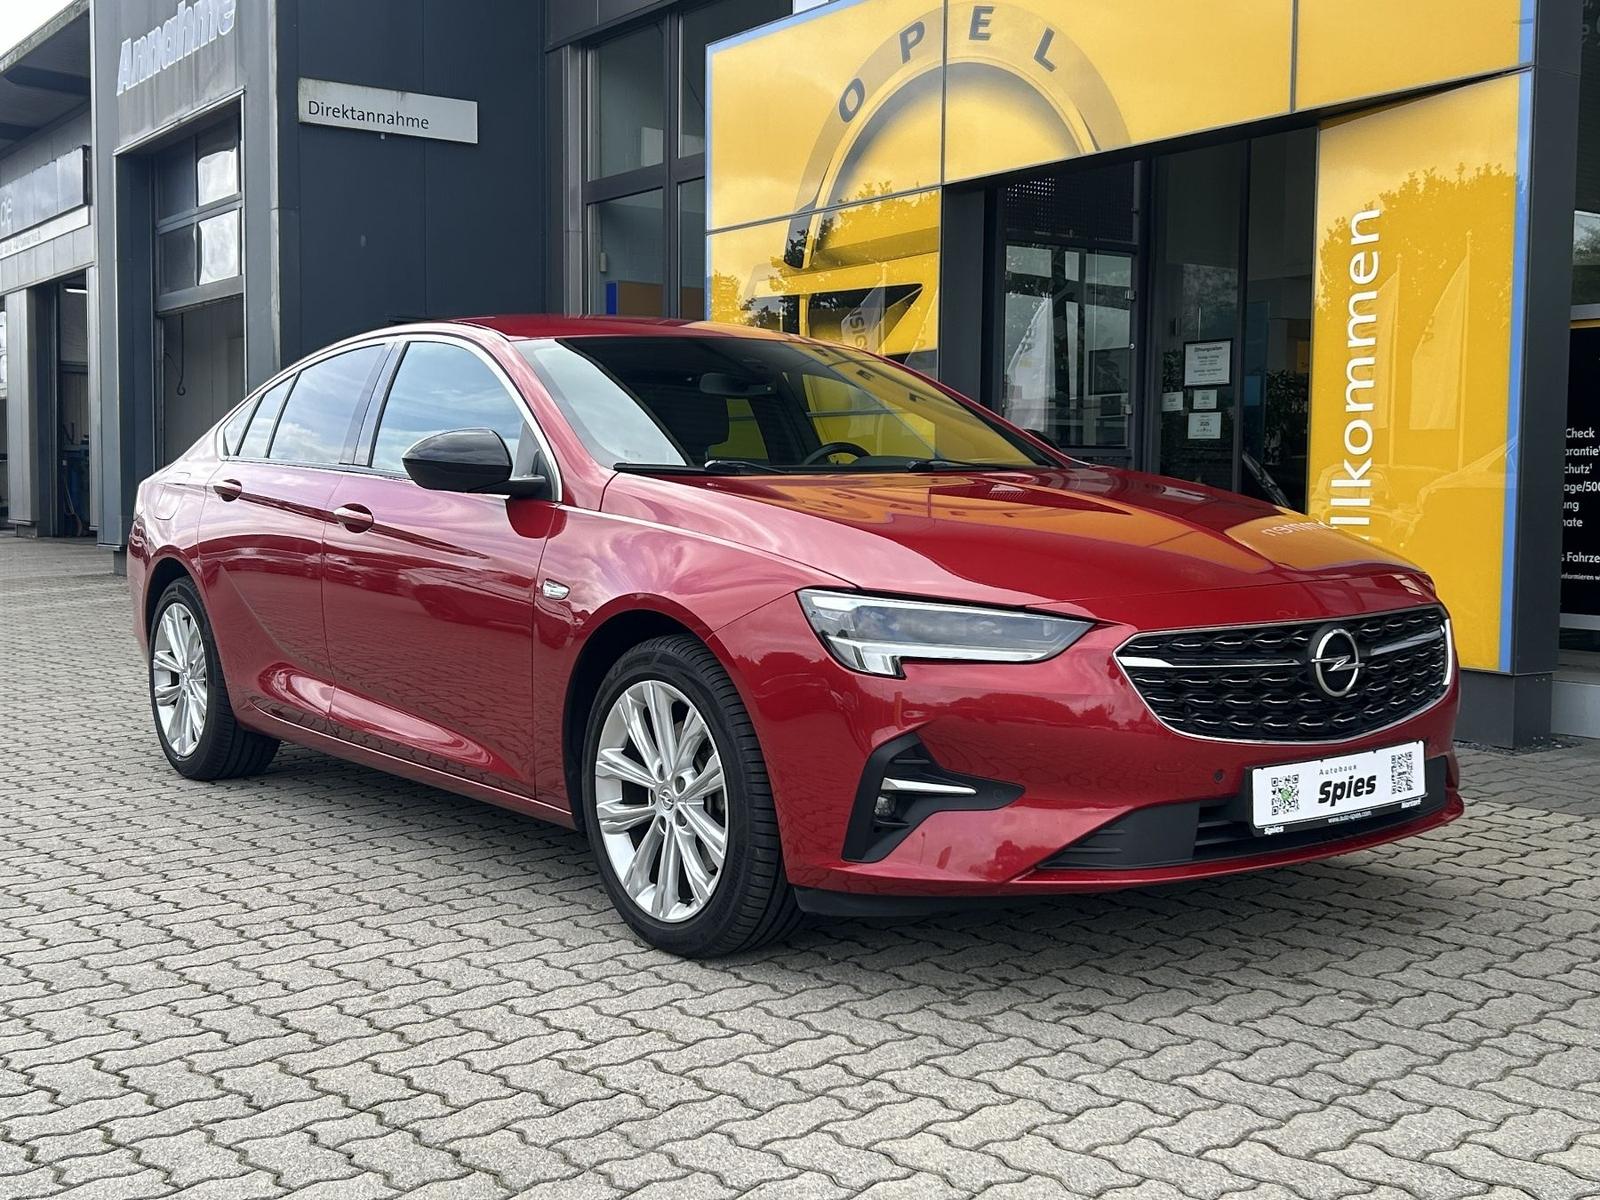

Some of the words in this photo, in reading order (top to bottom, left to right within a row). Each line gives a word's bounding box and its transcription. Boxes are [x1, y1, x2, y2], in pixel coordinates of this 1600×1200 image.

[116, 0, 237, 97] Annahme
[838, 5, 1058, 123] OPEL
[308, 100, 430, 130] Direktannahme
[1329, 207, 1381, 526] llkommen
[1565, 427, 1595, 438] Check
[1317, 774, 1377, 807] Spies
